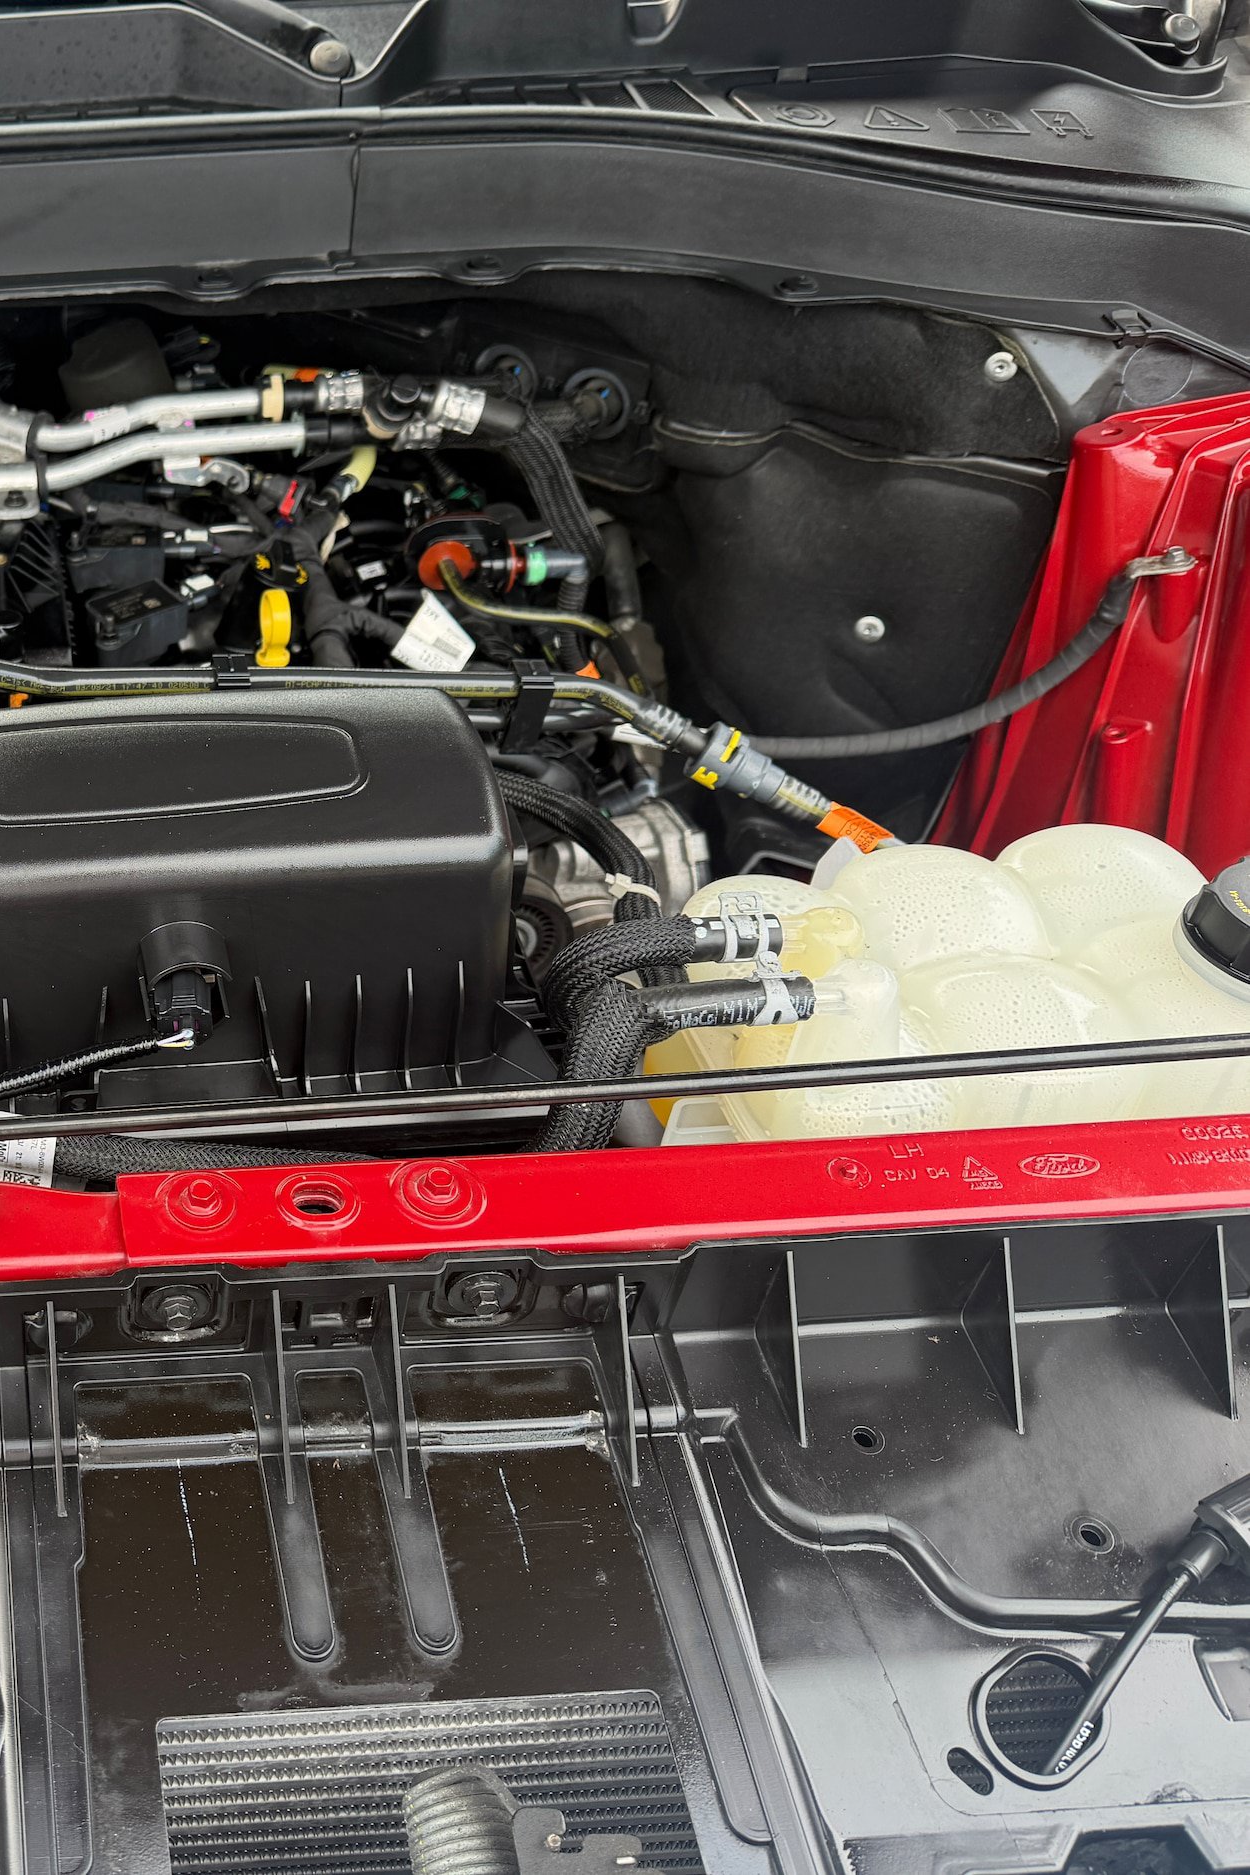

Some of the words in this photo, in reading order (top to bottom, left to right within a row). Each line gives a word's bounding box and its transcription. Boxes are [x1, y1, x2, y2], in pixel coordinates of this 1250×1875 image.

[888, 1142, 924, 1159] LH
[1030, 1153, 1090, 1176] Ford
[884, 1167, 918, 1182] CAV
